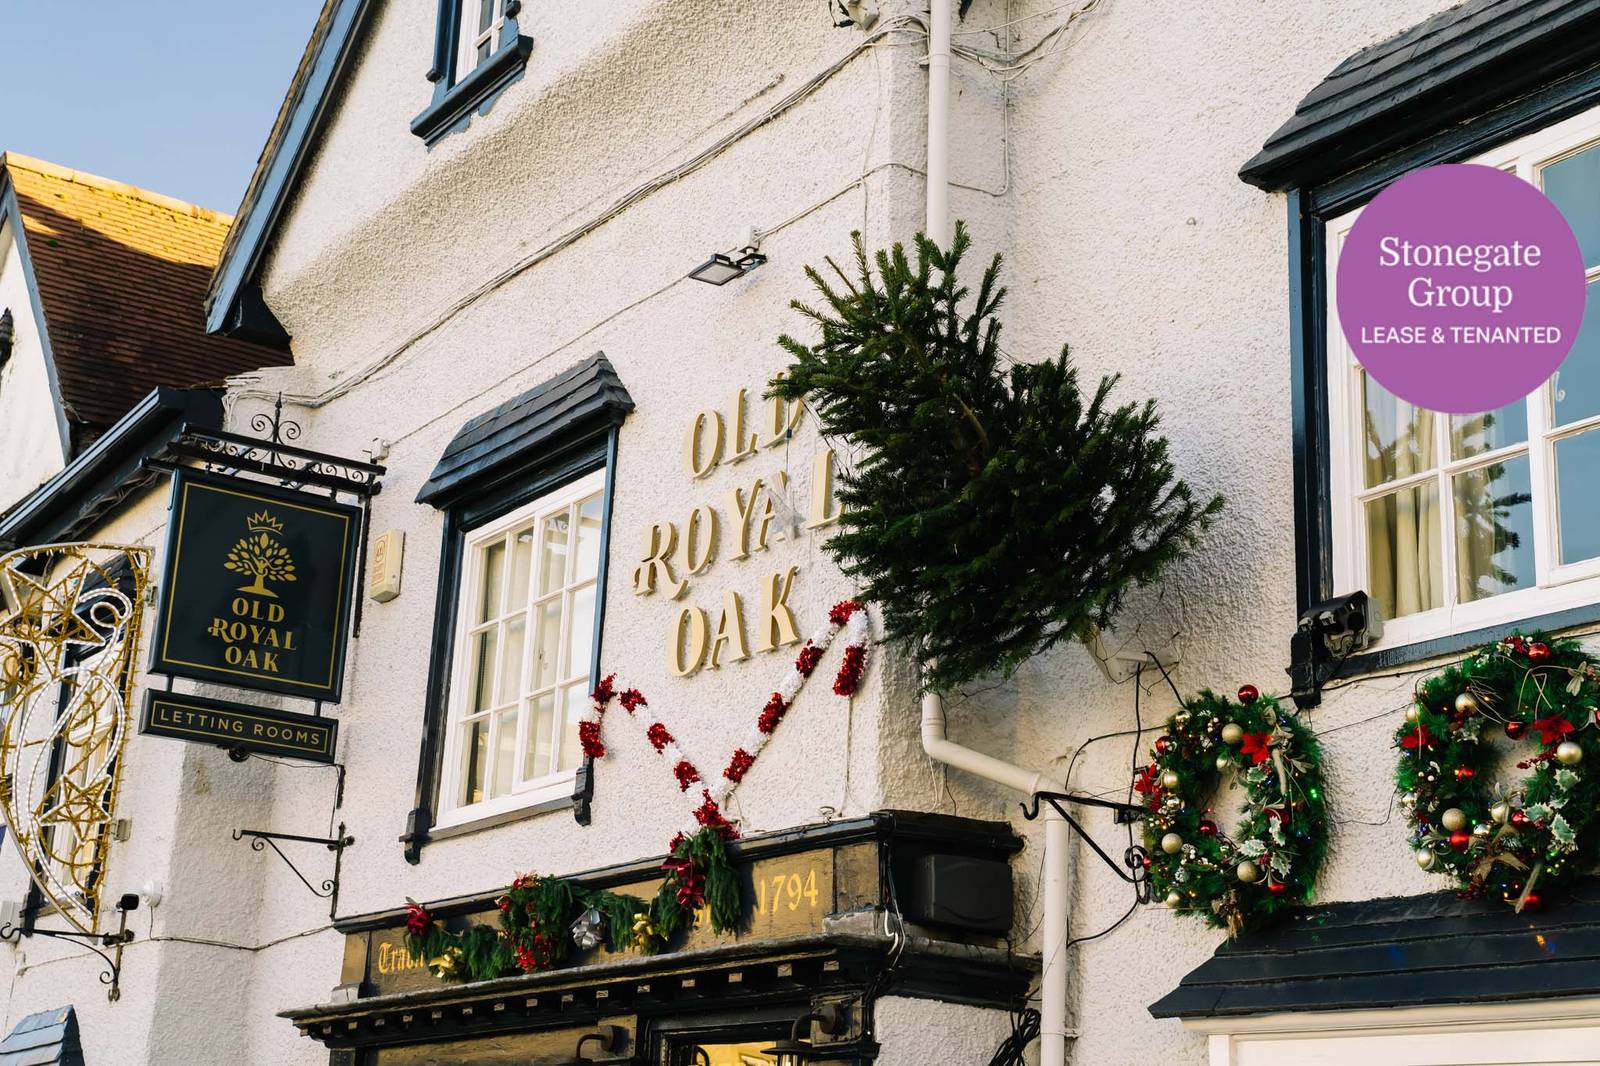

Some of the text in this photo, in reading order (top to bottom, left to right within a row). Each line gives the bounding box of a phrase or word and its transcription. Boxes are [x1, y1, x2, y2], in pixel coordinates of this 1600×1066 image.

[231, 597, 285, 623] OLD
[667, 565, 801, 678] OAK
[207, 617, 298, 651] ROYAL
[224, 646, 280, 673] OAK
[160, 708, 321, 745] LETTING ROOMS
[758, 868, 819, 916] 1794
